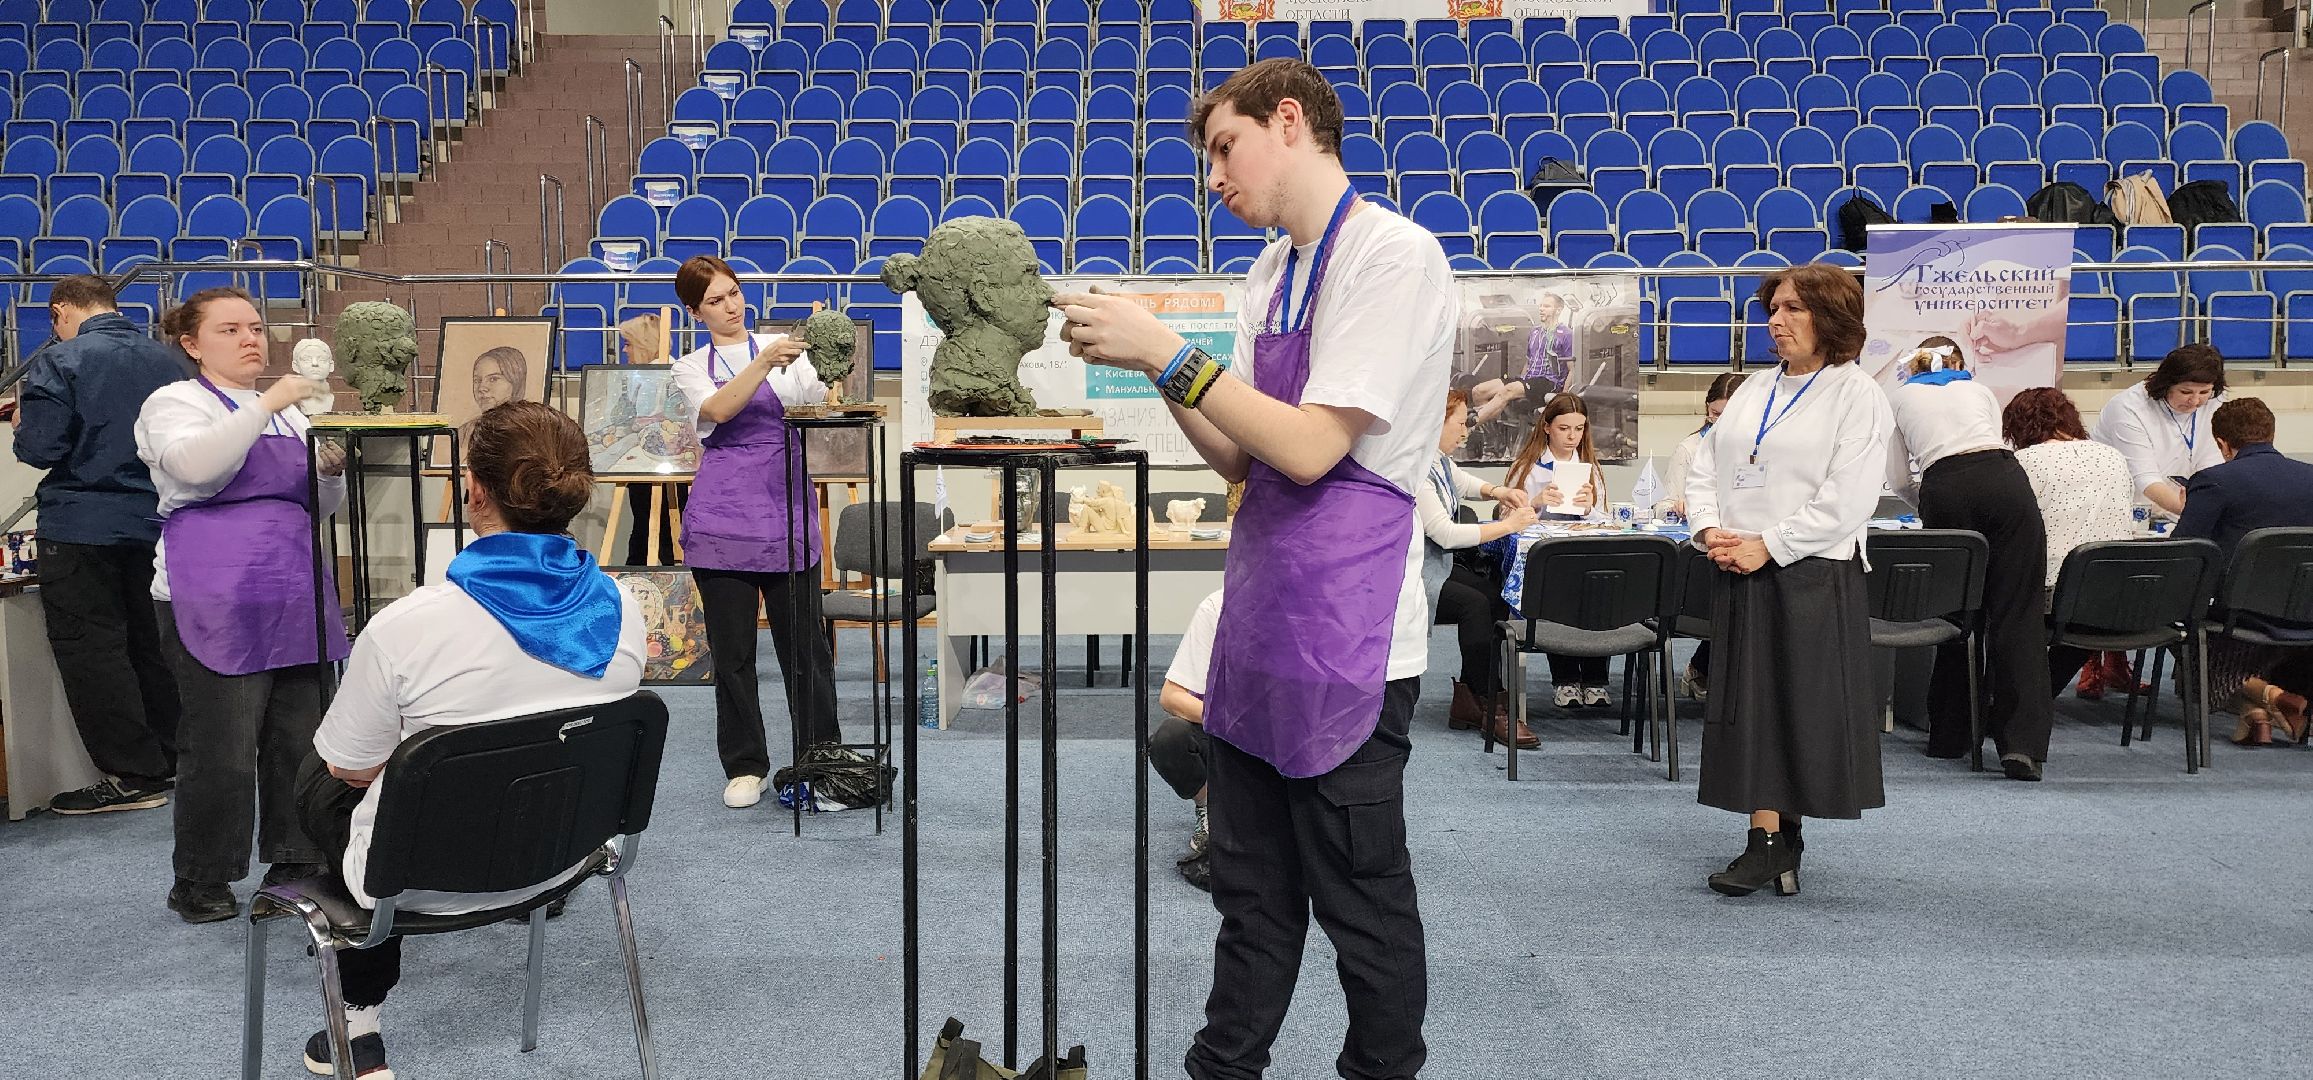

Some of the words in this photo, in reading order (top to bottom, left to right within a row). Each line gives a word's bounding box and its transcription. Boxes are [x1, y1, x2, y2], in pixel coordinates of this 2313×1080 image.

[1285, 9, 1351, 20] ОБЛАСТИ
[1915, 264, 2055, 283] Гжельский
[1914, 284, 2055, 297] государственный
[1164, 297, 1216, 309] РЯДОМ!
[1914, 299, 2053, 315] университет
